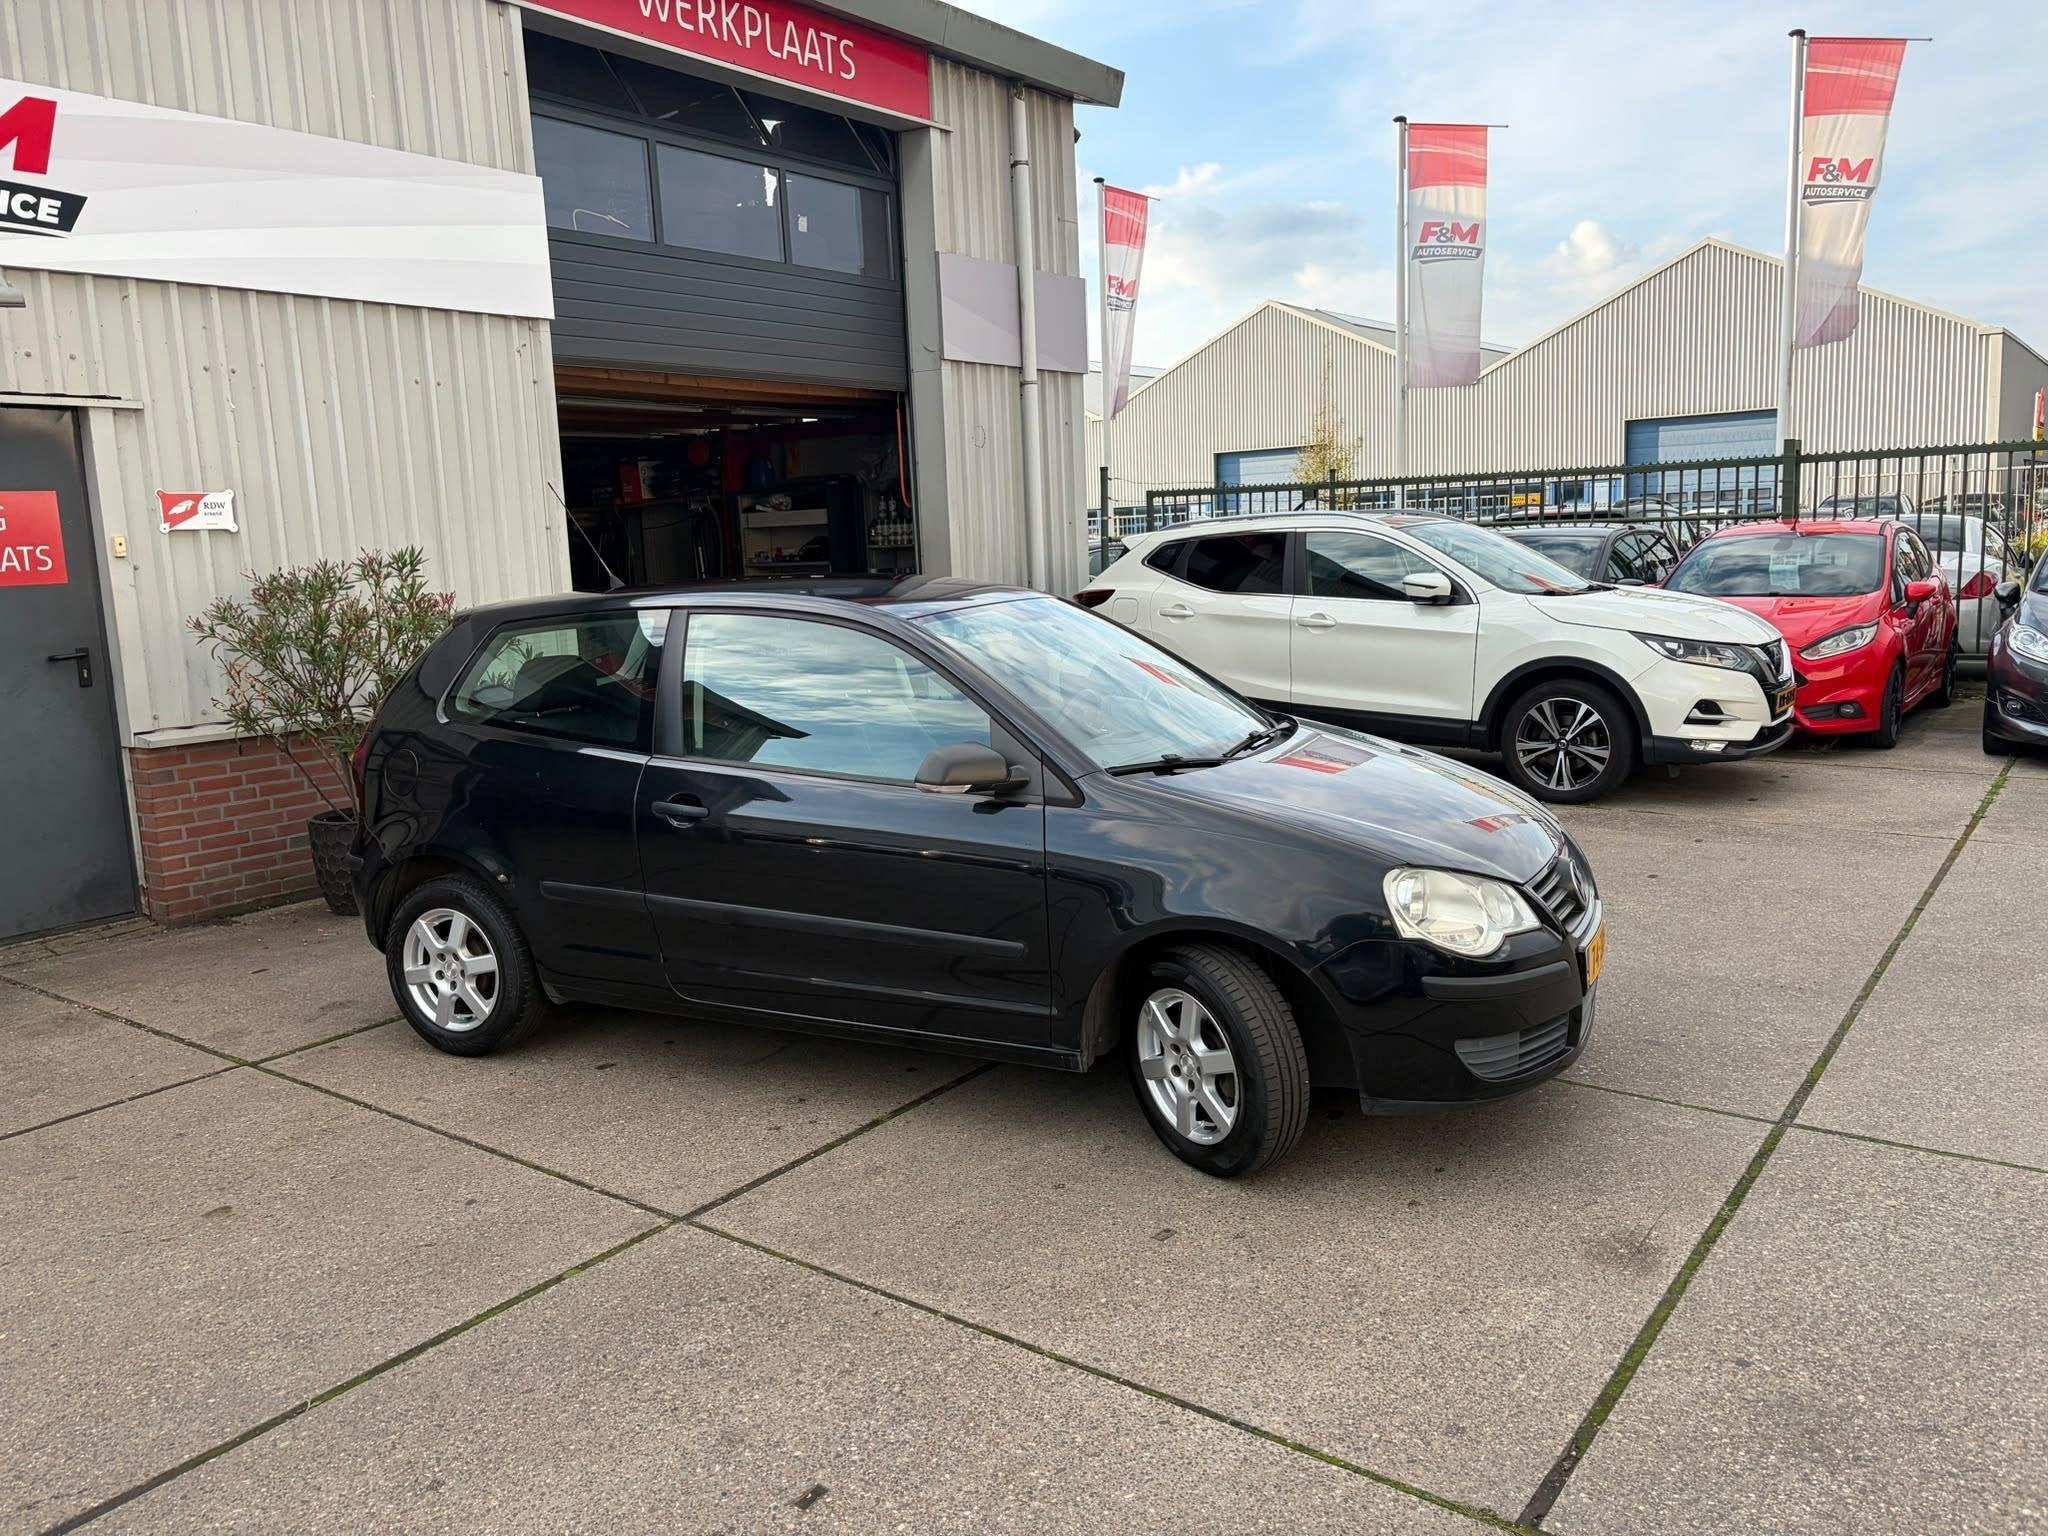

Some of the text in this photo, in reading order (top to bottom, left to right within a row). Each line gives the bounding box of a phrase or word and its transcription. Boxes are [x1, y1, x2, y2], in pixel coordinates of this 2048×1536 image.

[1807, 156, 1874, 183] F&M
[1804, 187, 1868, 198] AUTOSERVICE
[1419, 221, 1480, 244] F&M
[1417, 247, 1478, 257] AUTOSERVICE
[203, 501, 226, 510] RDW
